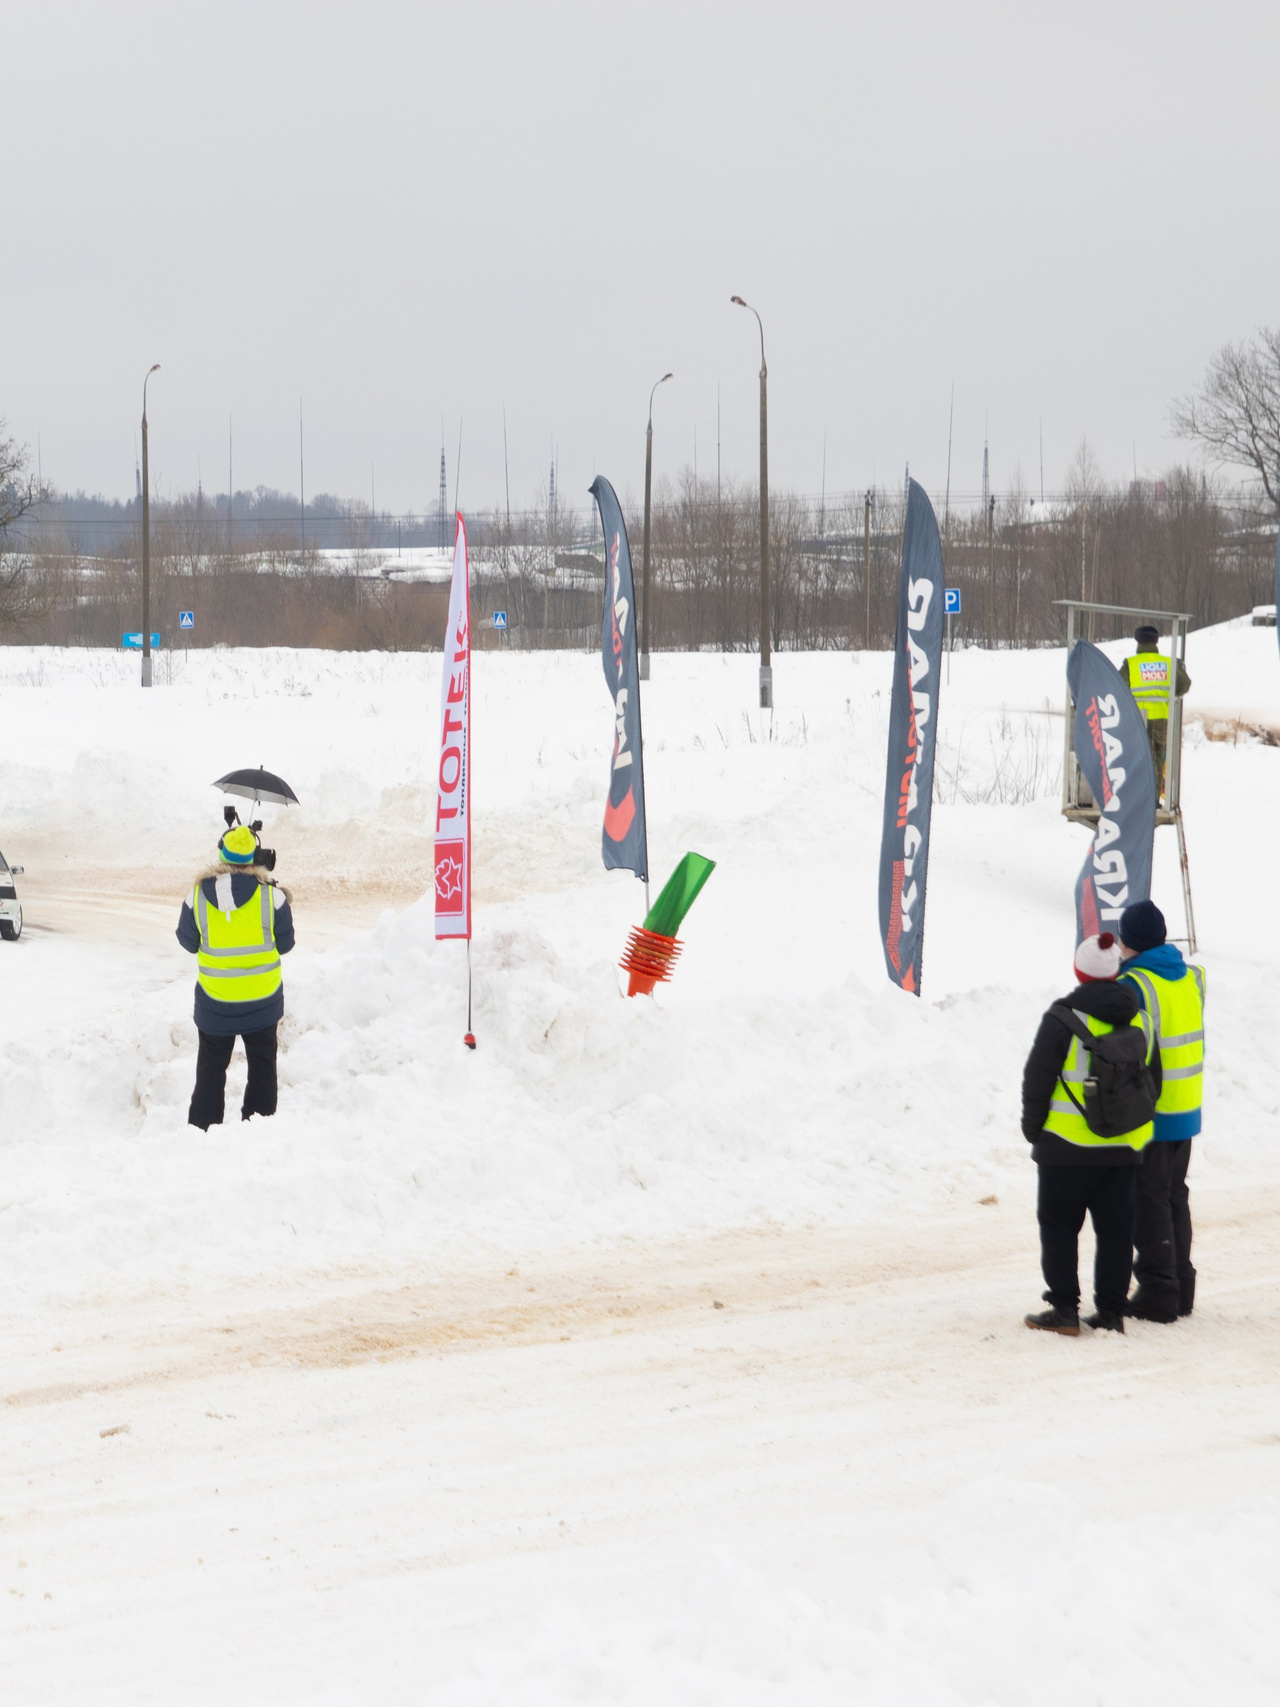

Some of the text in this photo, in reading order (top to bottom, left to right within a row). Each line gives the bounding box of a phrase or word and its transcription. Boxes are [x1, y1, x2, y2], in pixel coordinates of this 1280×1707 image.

[945, 592, 957, 611] P
[1140, 662, 1168, 672] LIQUI
[1142, 671, 1168, 681] MOLY
